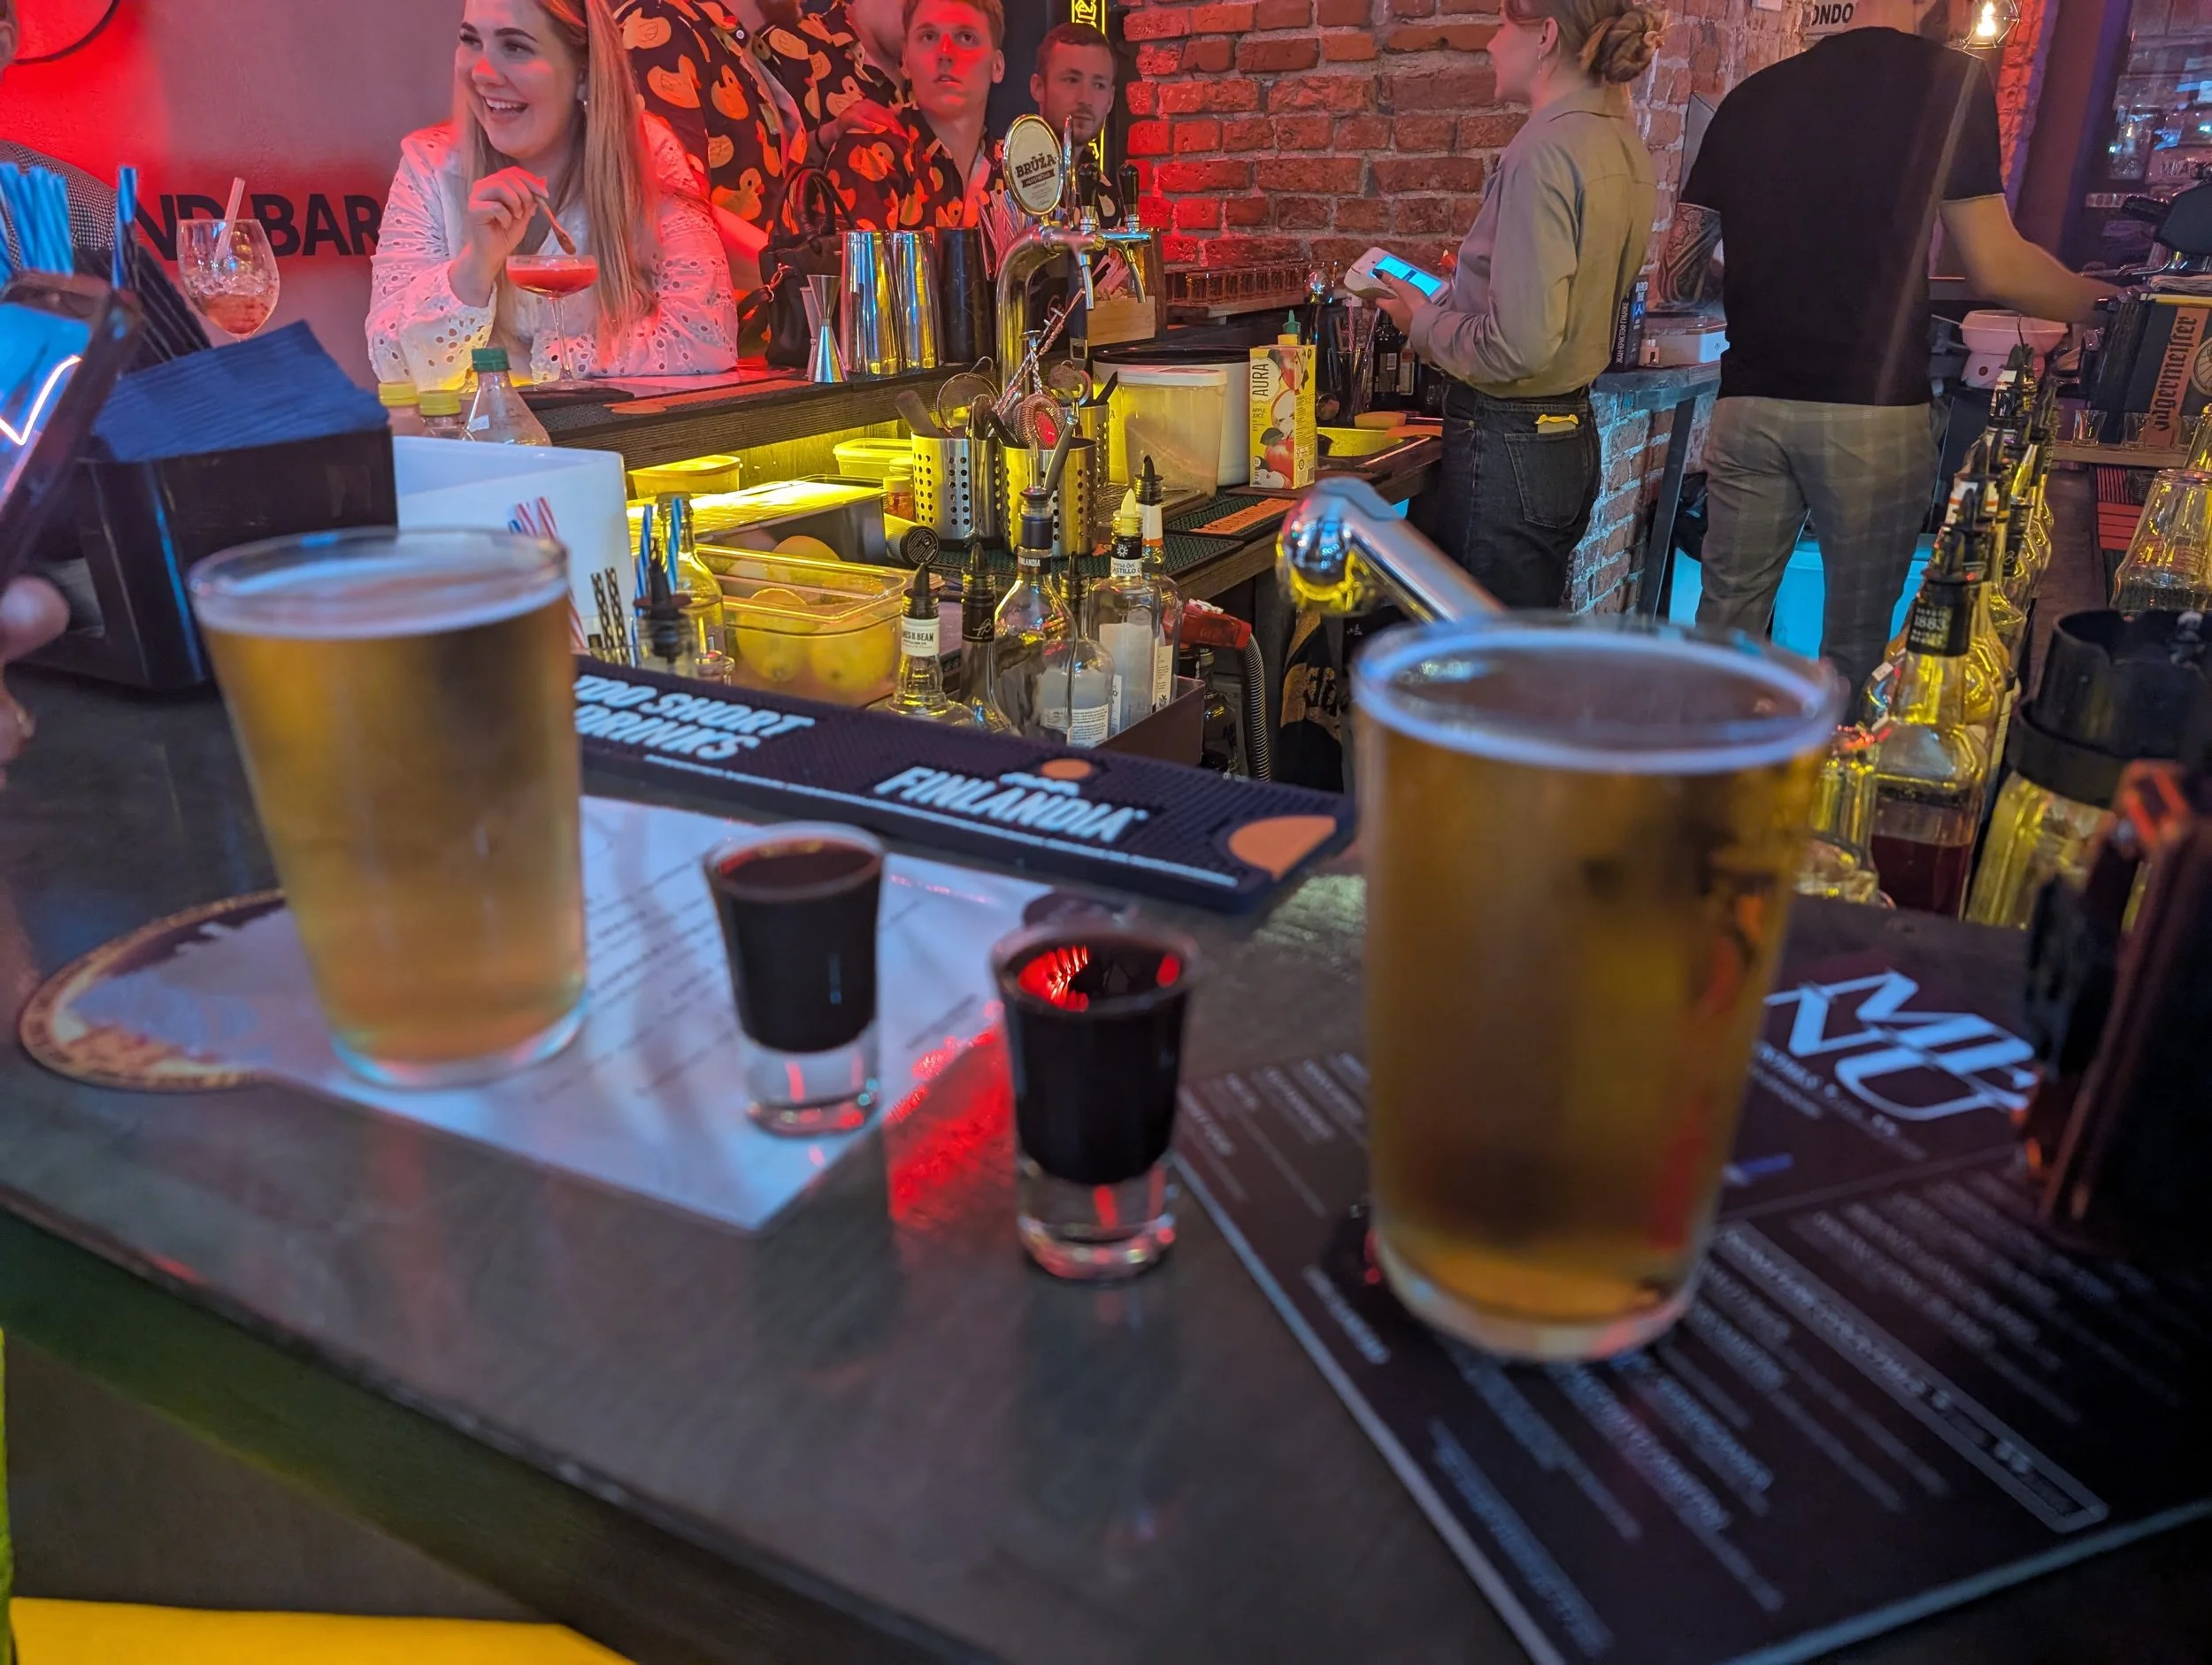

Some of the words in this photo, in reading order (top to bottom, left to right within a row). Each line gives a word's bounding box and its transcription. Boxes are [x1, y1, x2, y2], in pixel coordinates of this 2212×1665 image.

[250, 193, 381, 257] BAR
[1252, 364, 1270, 397] AURA
[917, 633, 934, 642] BEAM
[637, 692, 815, 737] SHORT
[872, 765, 1136, 843] FINLANDIA
